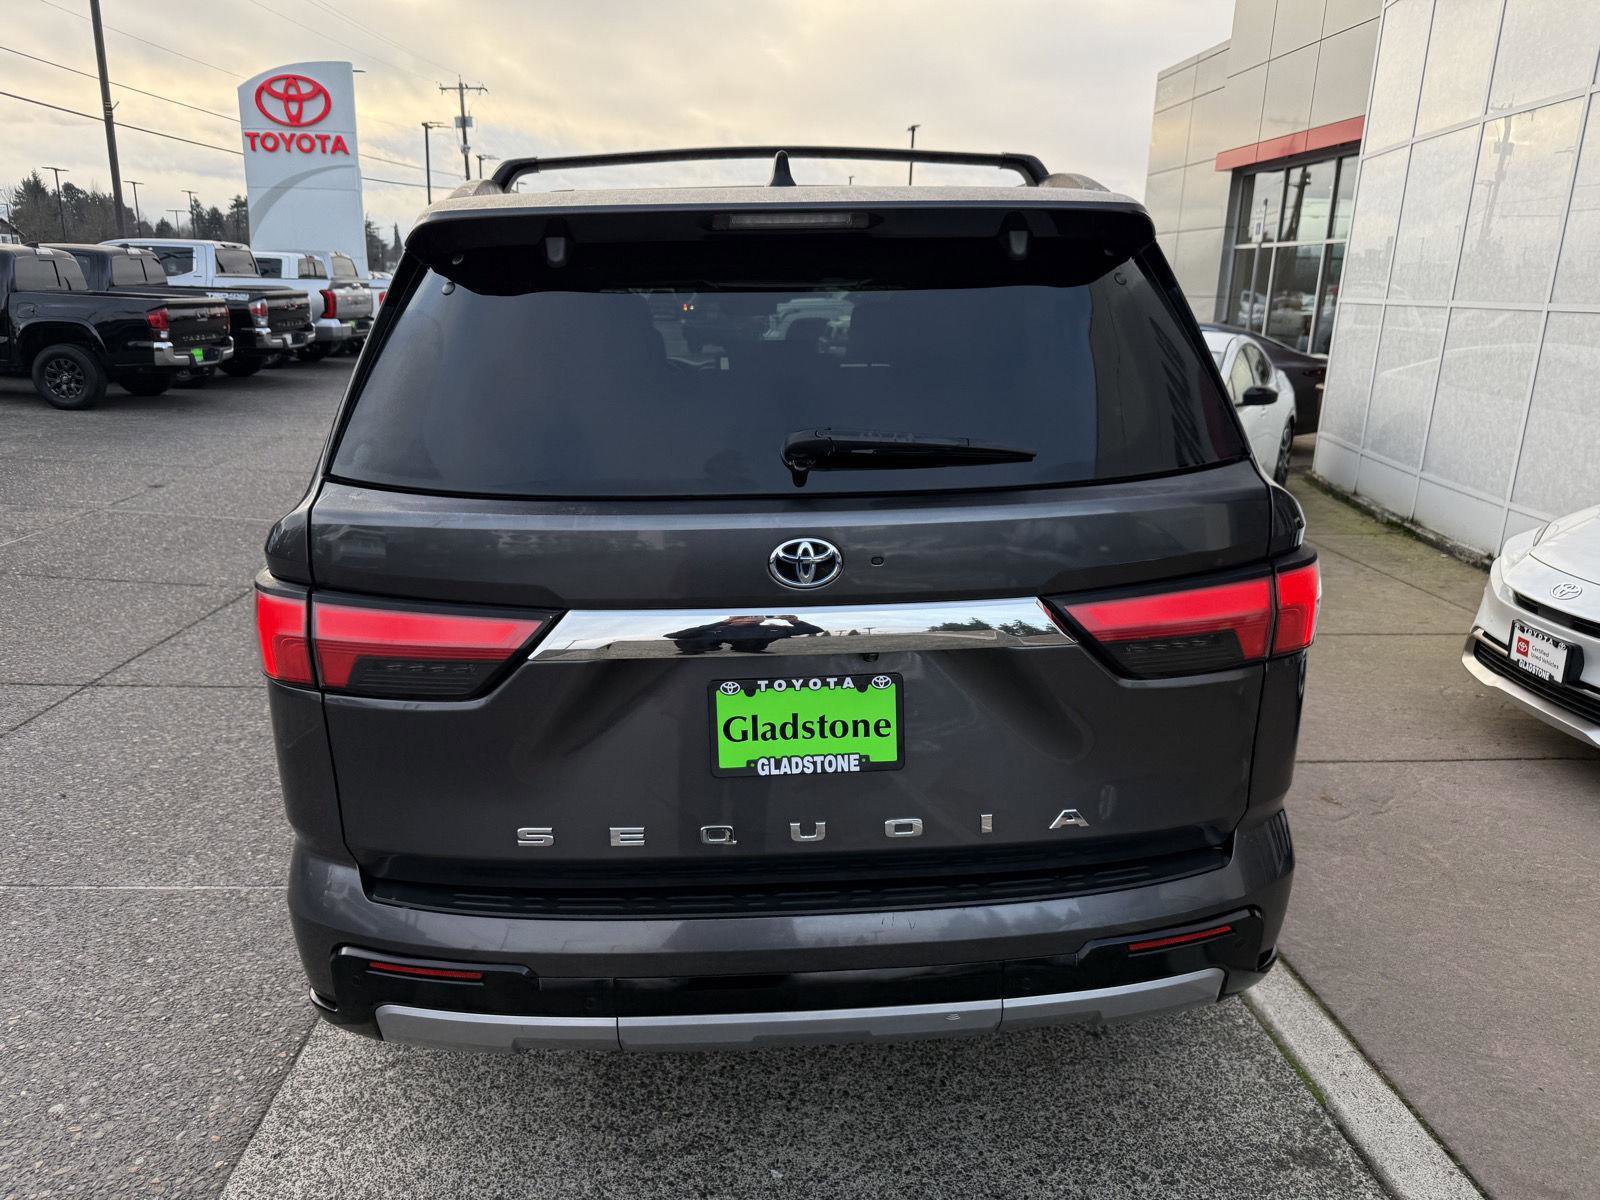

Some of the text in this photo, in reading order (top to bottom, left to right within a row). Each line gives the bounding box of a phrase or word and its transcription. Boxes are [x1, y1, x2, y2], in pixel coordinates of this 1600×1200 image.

[244, 131, 350, 155] TOYOTA
[1523, 626, 1553, 645] TOYOTA
[1531, 645, 1550, 658] Certified
[1518, 659, 1550, 681] GLADSTONE
[757, 677, 855, 692] TOYOTA
[722, 713, 892, 743] Gladstone
[757, 754, 860, 776] GLADSTONE
[517, 808, 1090, 847] SEQUOIA
